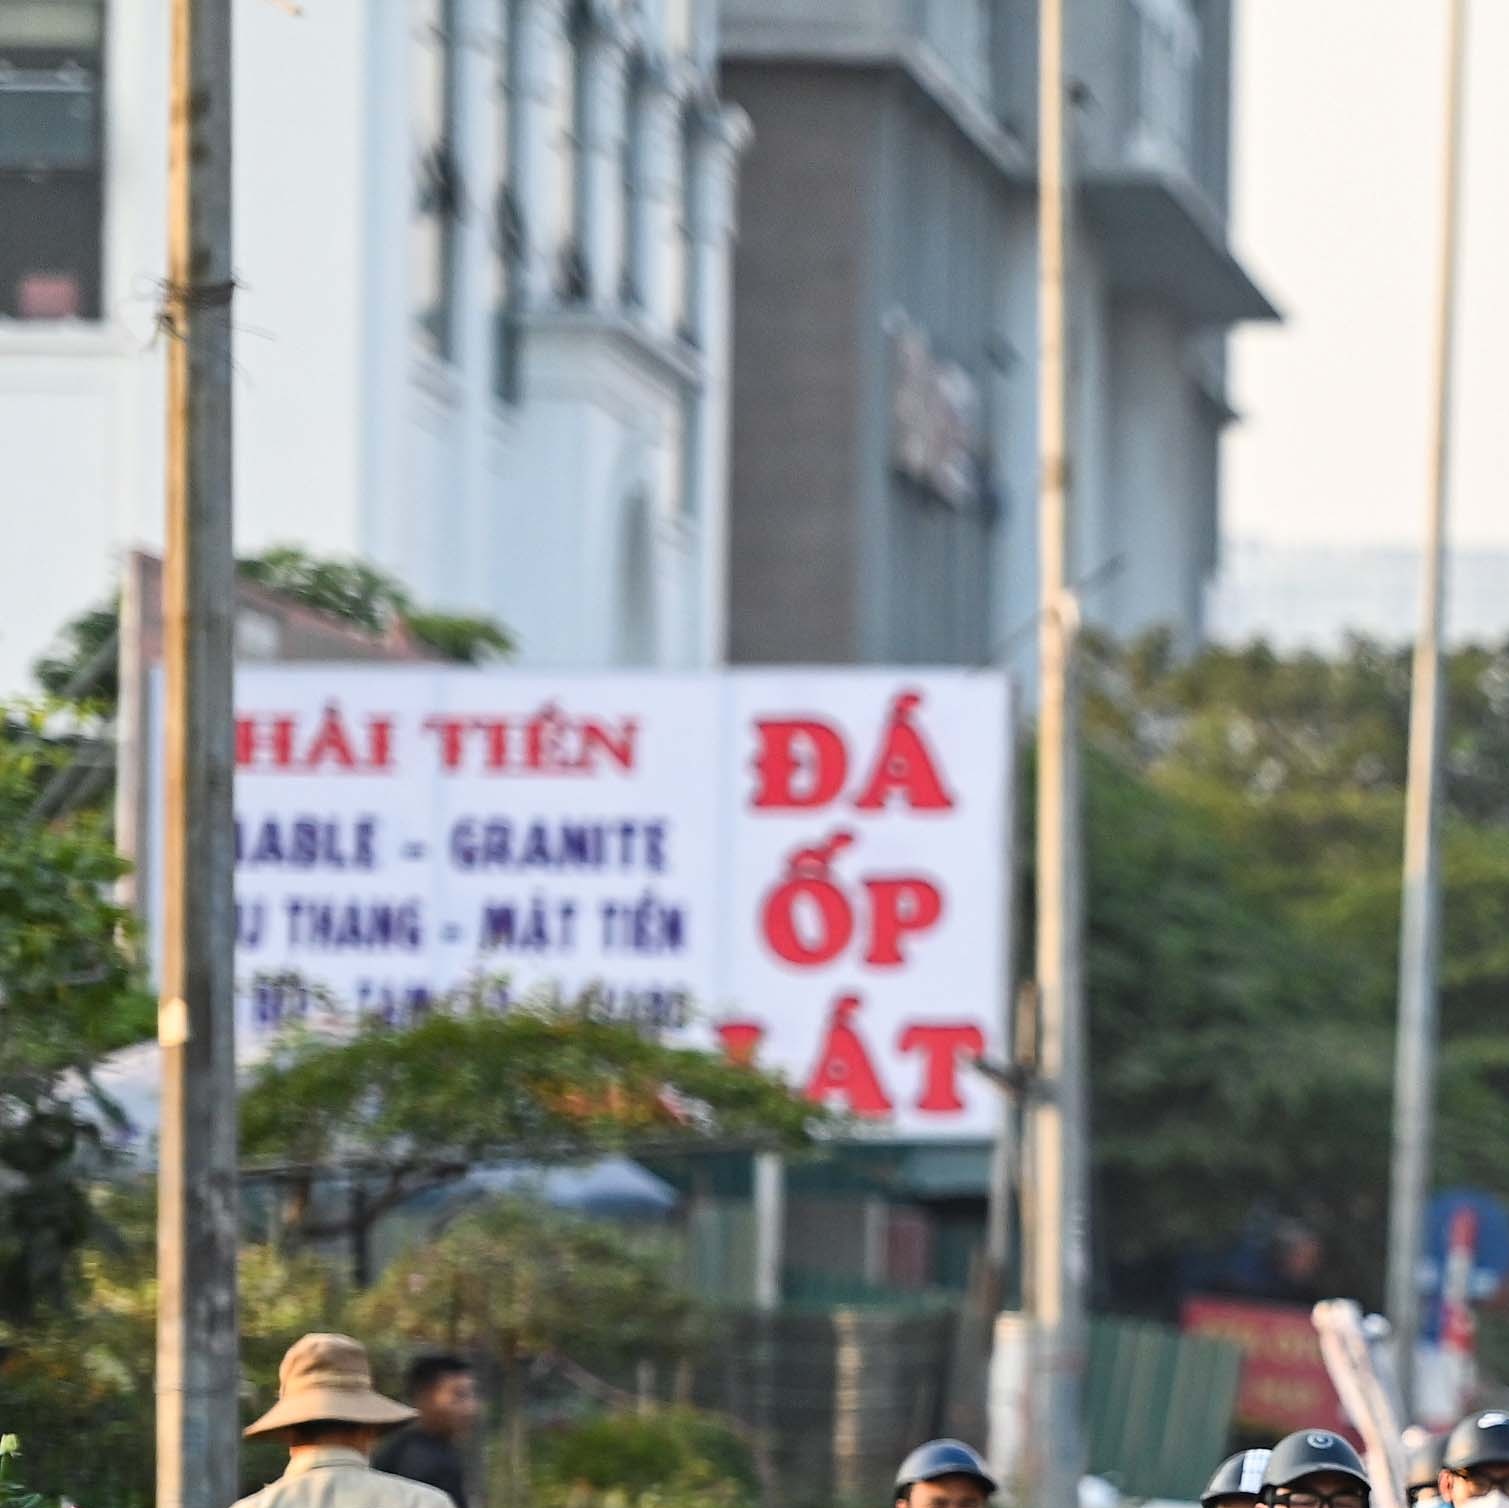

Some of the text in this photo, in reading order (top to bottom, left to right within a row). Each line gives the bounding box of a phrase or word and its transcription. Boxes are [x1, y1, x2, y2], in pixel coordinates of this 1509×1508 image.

[750, 689, 956, 812] ĐÁ
[450, 813, 668, 872] GRANITE
[284, 896, 424, 952] THANG
[758, 827, 945, 968] ỐP
